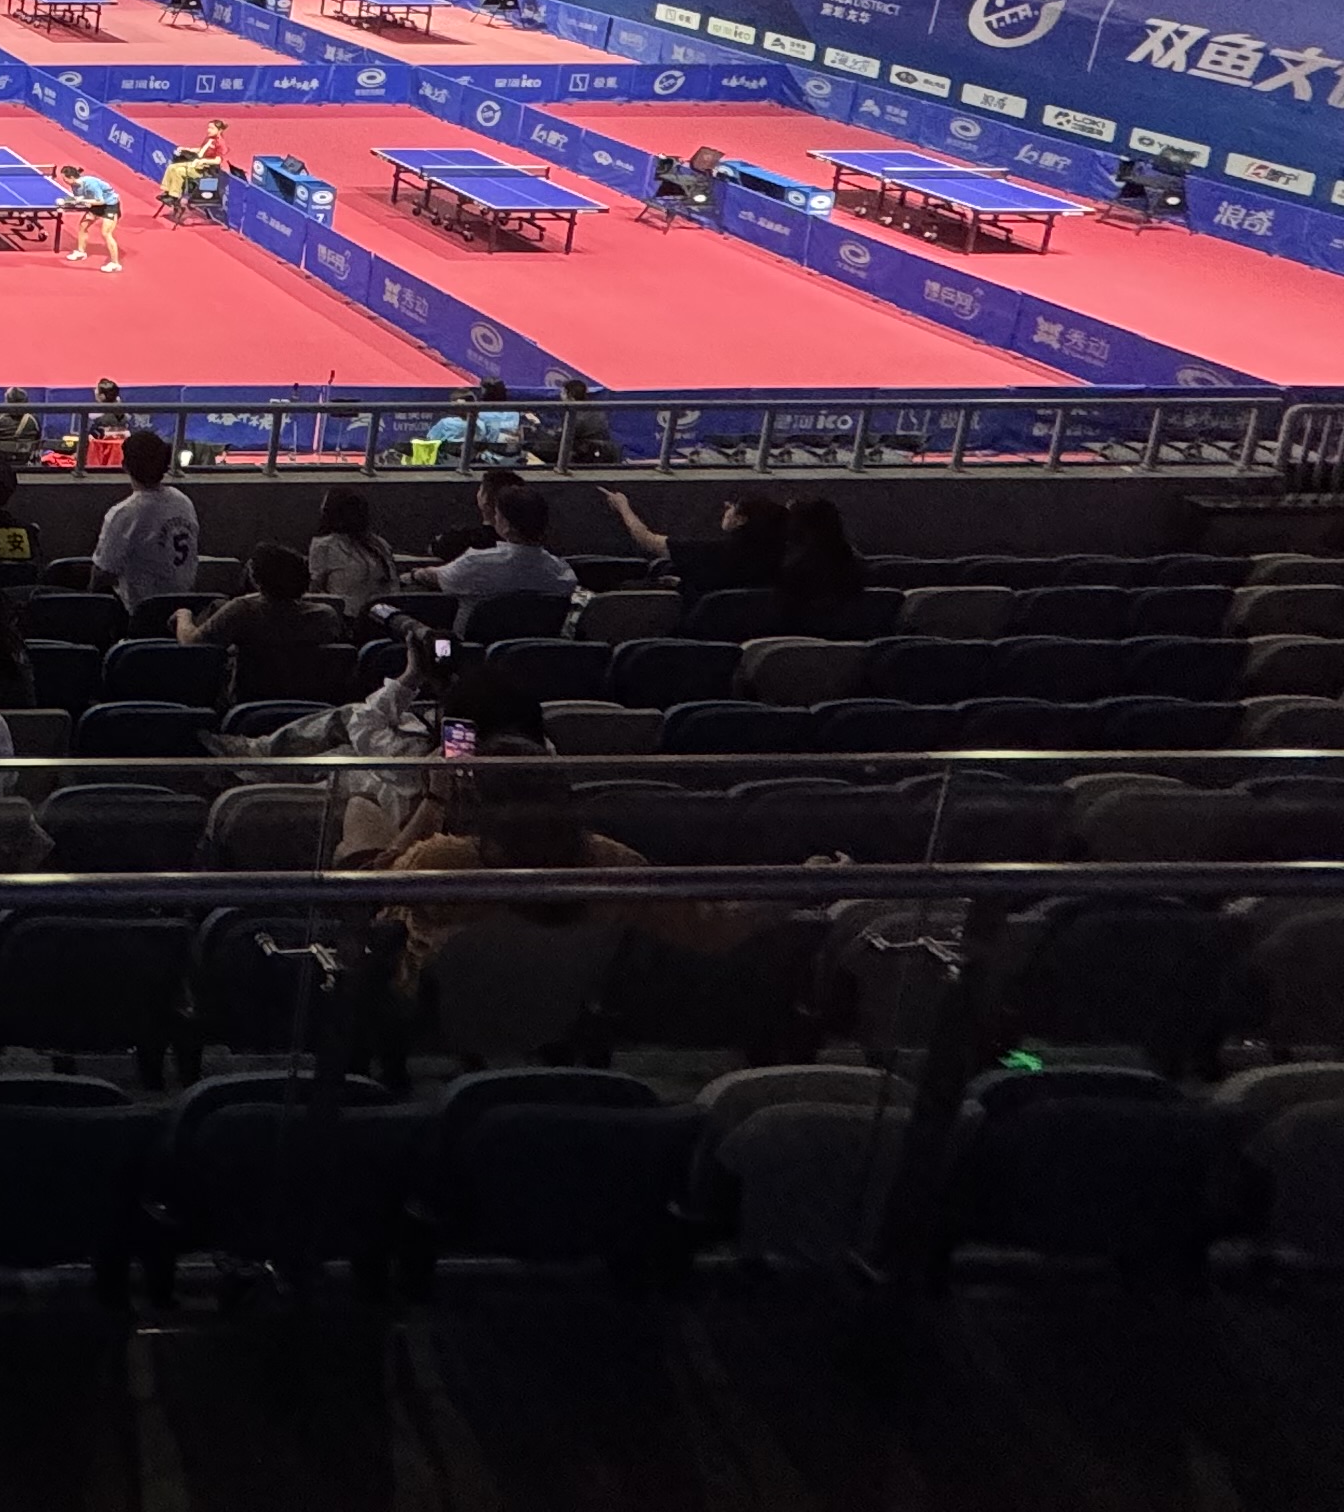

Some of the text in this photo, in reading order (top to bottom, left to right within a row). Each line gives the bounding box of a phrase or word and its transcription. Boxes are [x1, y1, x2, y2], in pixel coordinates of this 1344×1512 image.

[1126, 17, 1344, 109] 双鱼文
[1213, 200, 1275, 237] 浪奇
[173, 533, 189, 566] 5
